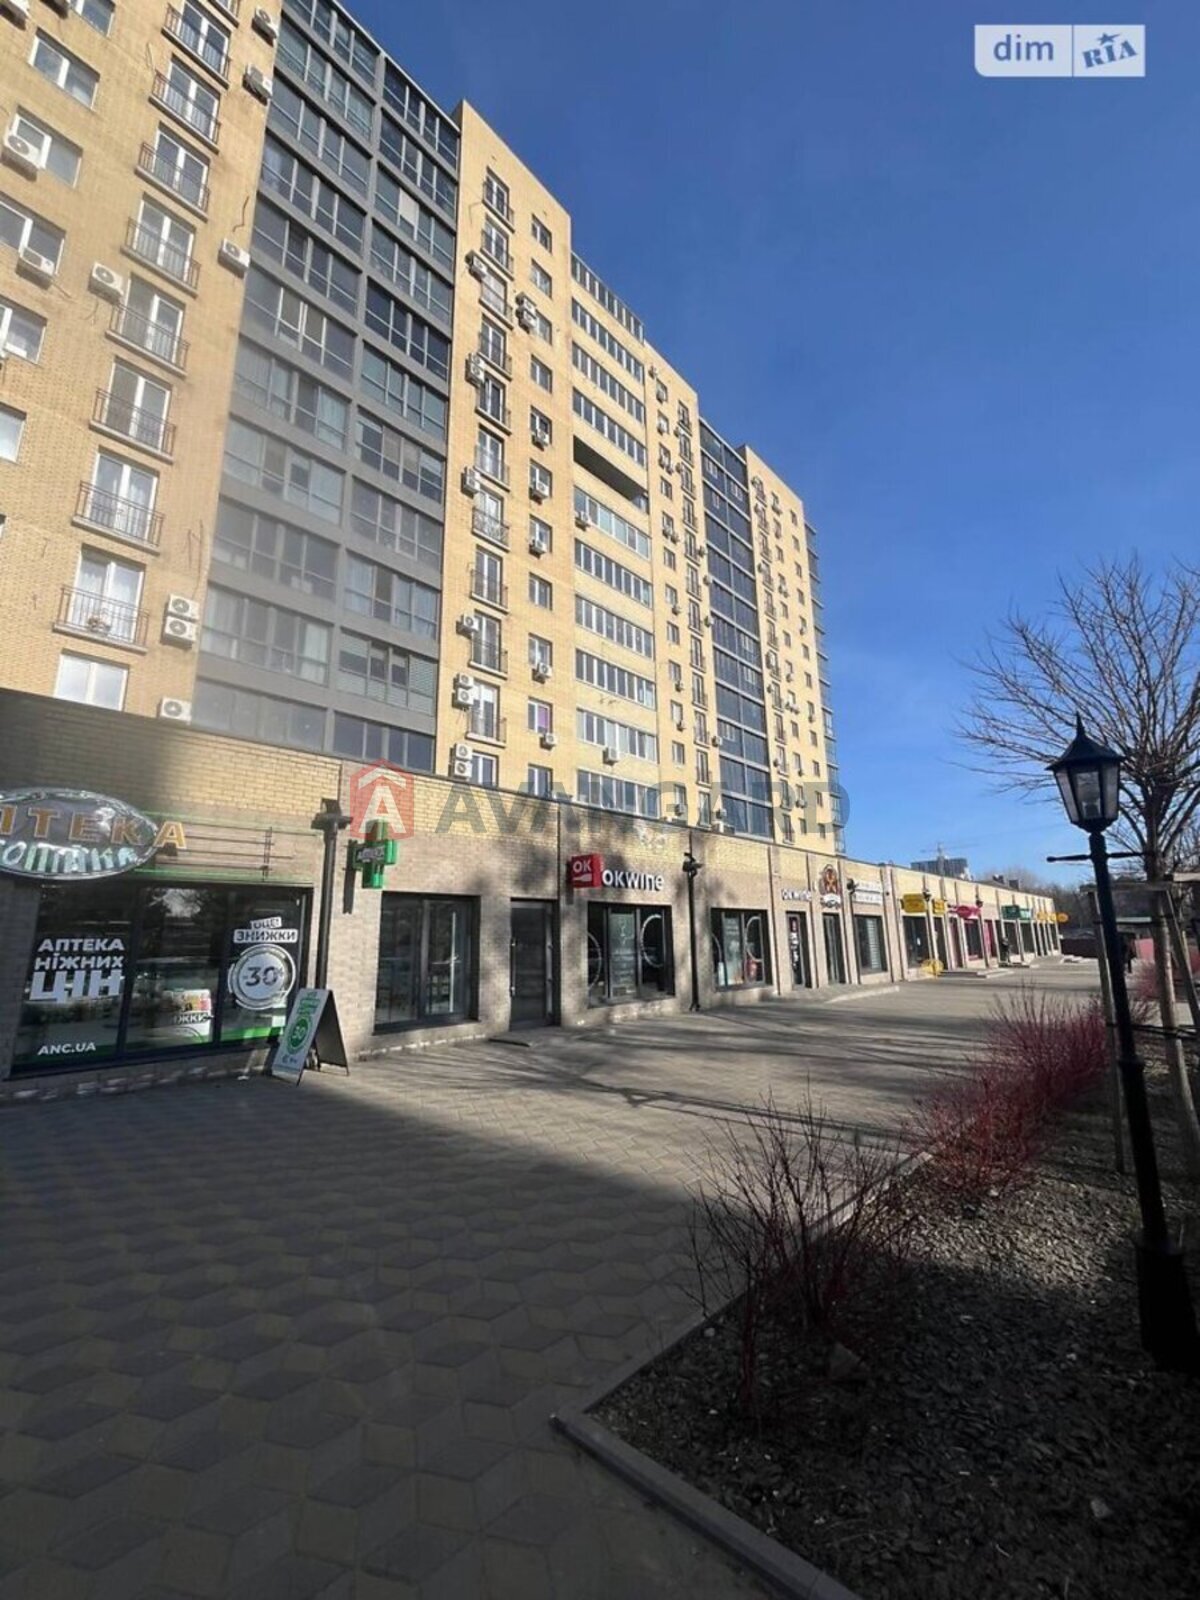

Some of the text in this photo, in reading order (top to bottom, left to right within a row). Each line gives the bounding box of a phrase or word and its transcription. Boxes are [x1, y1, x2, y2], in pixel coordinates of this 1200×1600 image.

[572, 860, 592, 873] OK
[236, 930, 296, 941] ЗНИЖКИ
[38, 938, 125, 952] АПТЕКА
[29, 970, 122, 1003] ЦІН
[37, 1042, 96, 1056] ANC.UA
